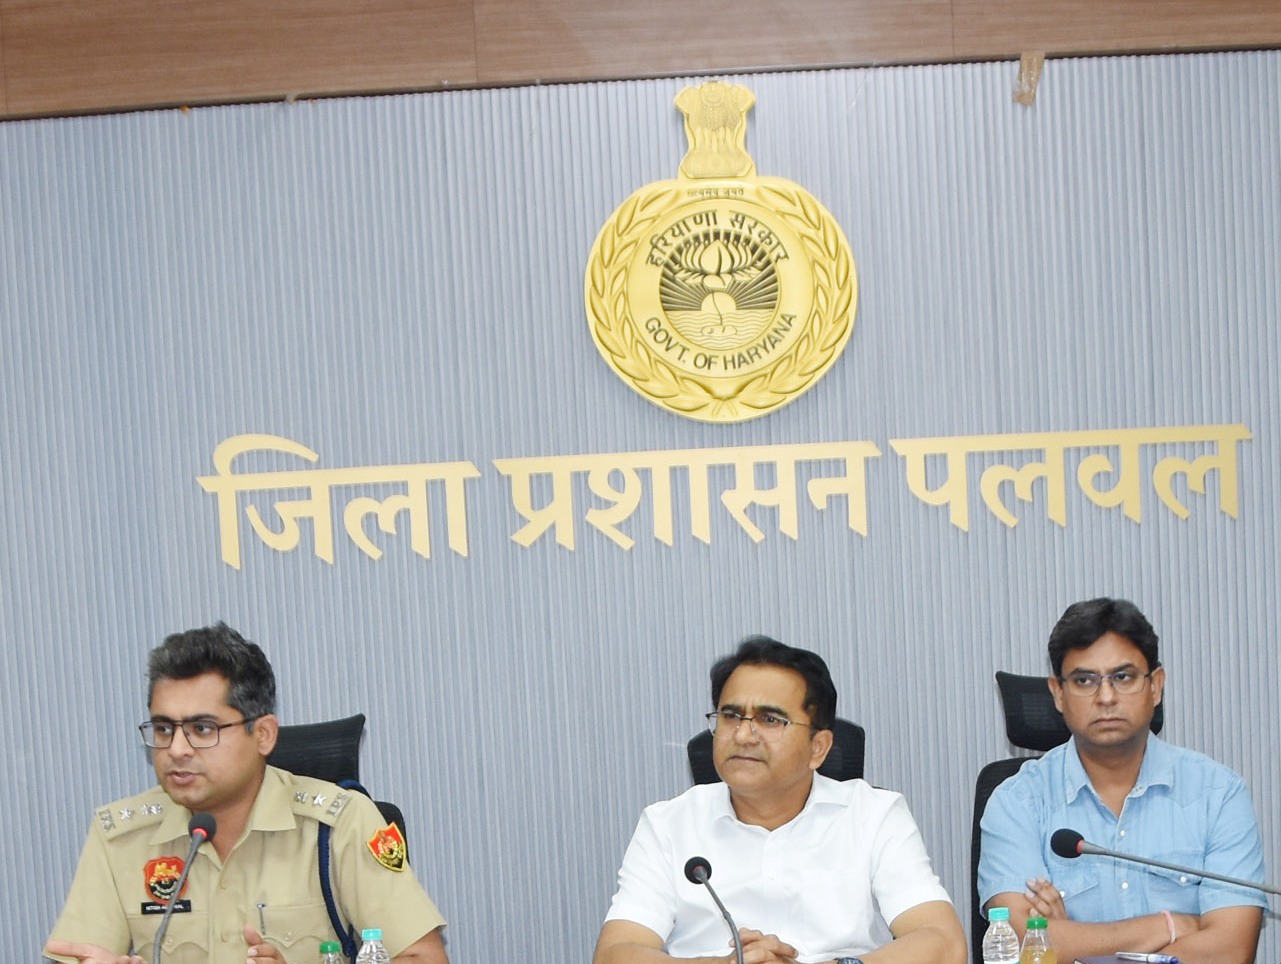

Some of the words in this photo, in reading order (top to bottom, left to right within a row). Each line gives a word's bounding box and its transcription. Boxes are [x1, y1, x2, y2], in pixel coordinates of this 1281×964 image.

[646, 210, 718, 267] हरियाणा
[729, 210, 789, 264] सरकार
[645, 316, 690, 364] GOVT.
[693, 353, 720, 371] OF
[723, 312, 797, 371] HARYANA
[196, 433, 481, 570] जिला
[491, 440, 882, 551] प्रशासन
[889, 423, 1254, 533] पलवल
